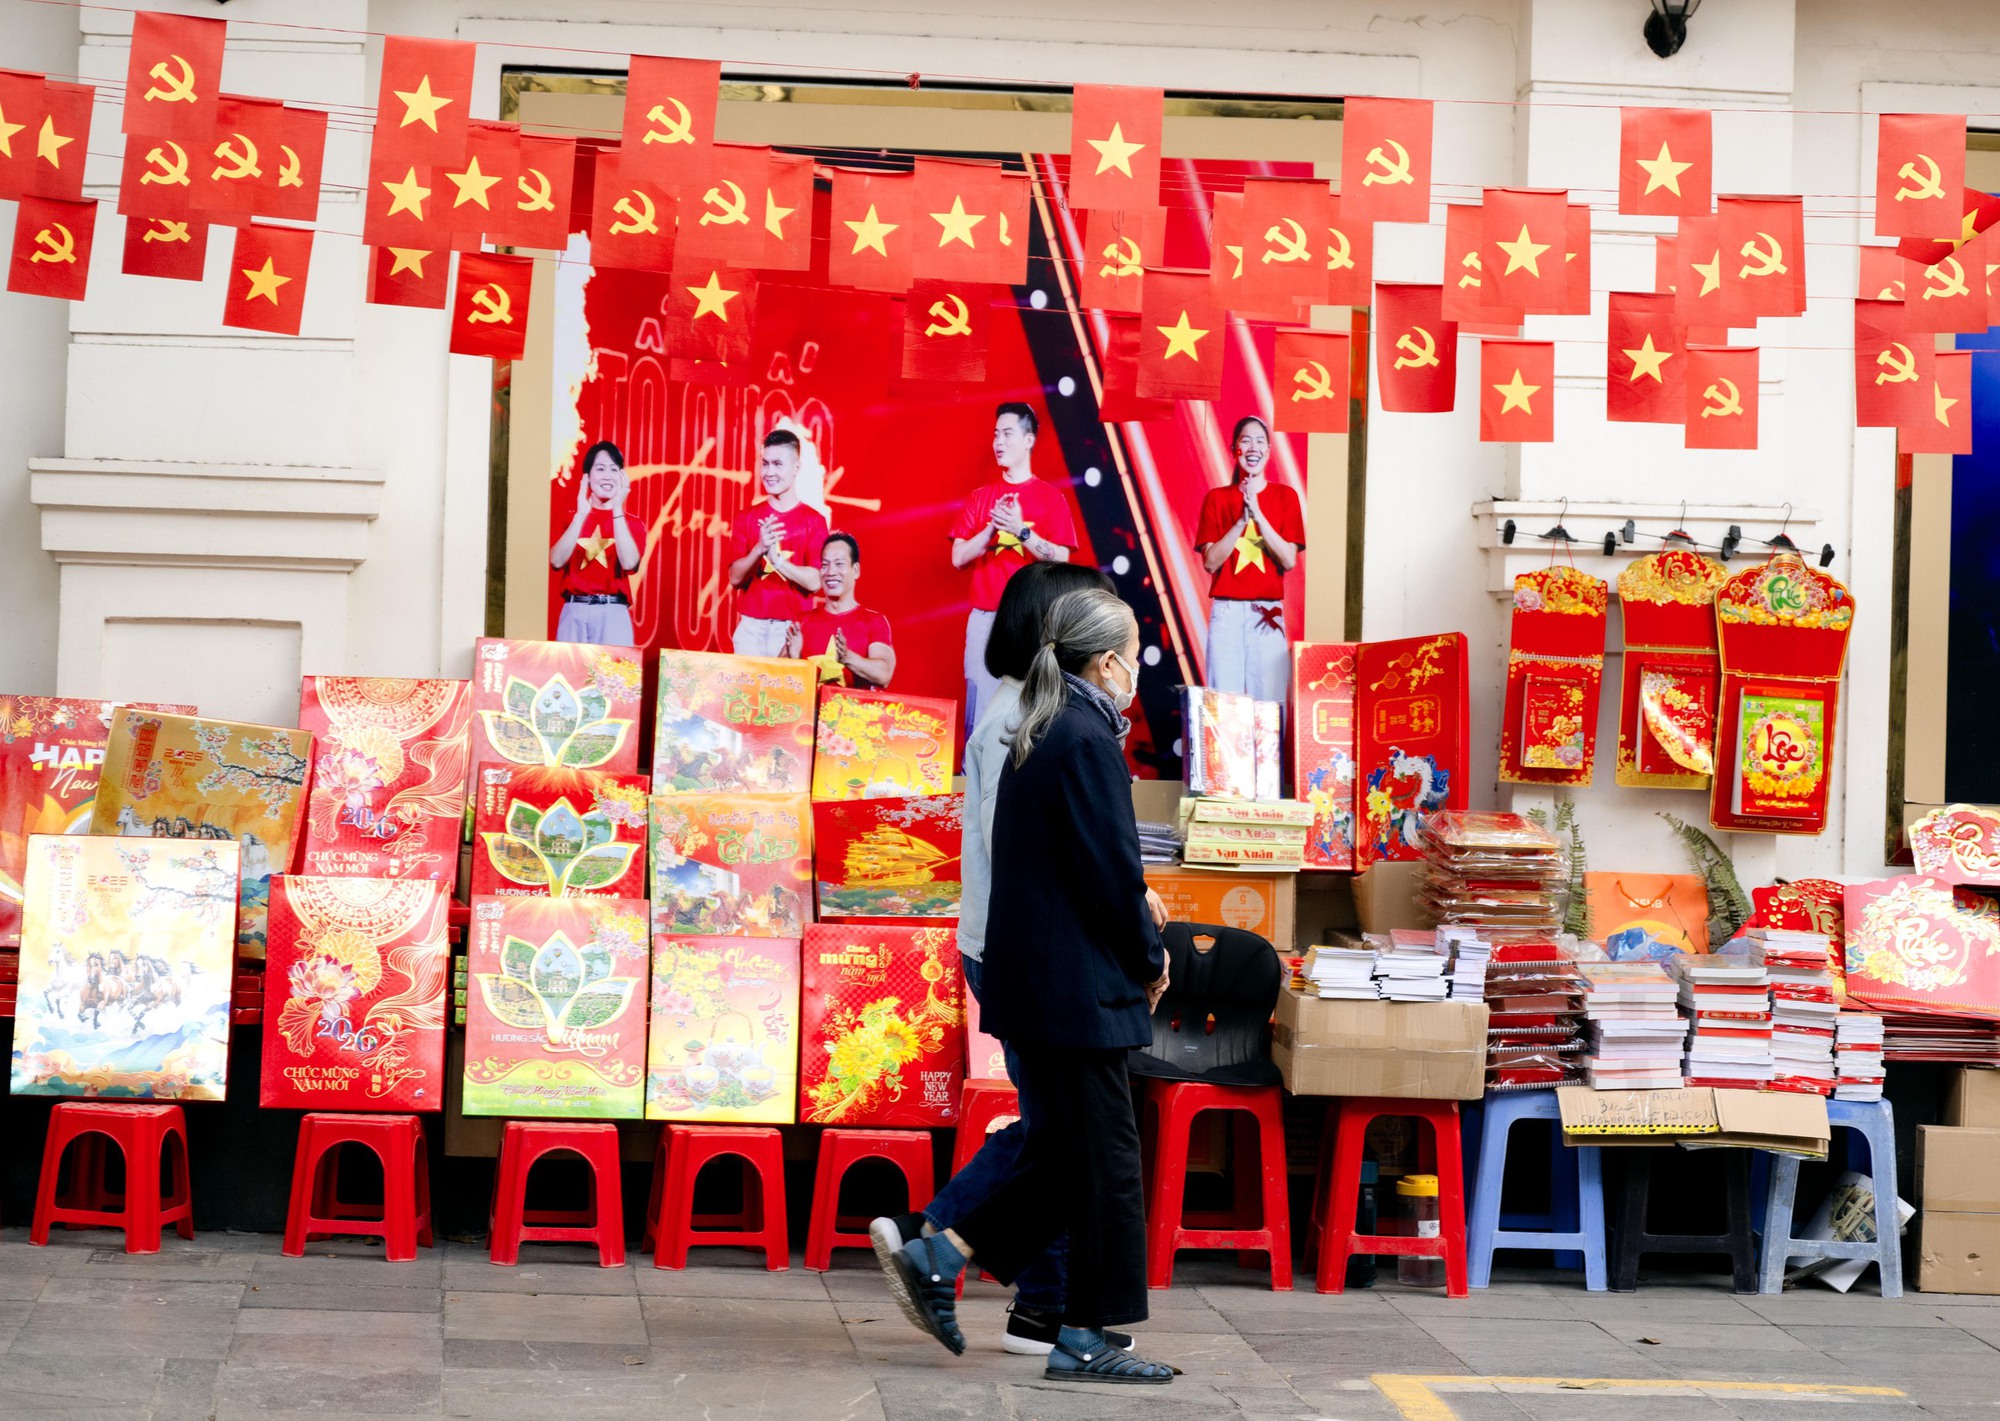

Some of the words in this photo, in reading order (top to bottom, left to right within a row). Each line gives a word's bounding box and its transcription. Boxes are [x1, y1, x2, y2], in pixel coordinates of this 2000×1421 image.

[1768, 576, 1805, 611] Phúc
[1762, 723, 1806, 771] Lộc
[28, 742, 106, 771] HAP
[50, 767, 99, 798] New
[308, 850, 342, 862] CHÚC
[343, 851, 378, 862] MỪNG
[1216, 848, 1239, 860] Vạn
[1242, 849, 1274, 860] Xuân
[316, 861, 343, 874] NĂM
[344, 863, 368, 874] MỚI
[495, 888, 530, 897] HƯƠNG
[531, 888, 549, 897] SẮC
[845, 944, 871, 953] Chúc
[820, 951, 878, 968] mừng
[317, 1017, 377, 1052] 2026
[491, 1033, 527, 1043] HƯƠNG
[529, 1032, 548, 1043] SẮC
[284, 1065, 320, 1078] CHÚC
[321, 1065, 359, 1079] MỪNG
[920, 1071, 952, 1082] HAPPY
[291, 1078, 323, 1092] NĂM
[325, 1077, 349, 1091] MỚI
[925, 1081, 948, 1091] NEW
[923, 1091, 949, 1102] YEAR
